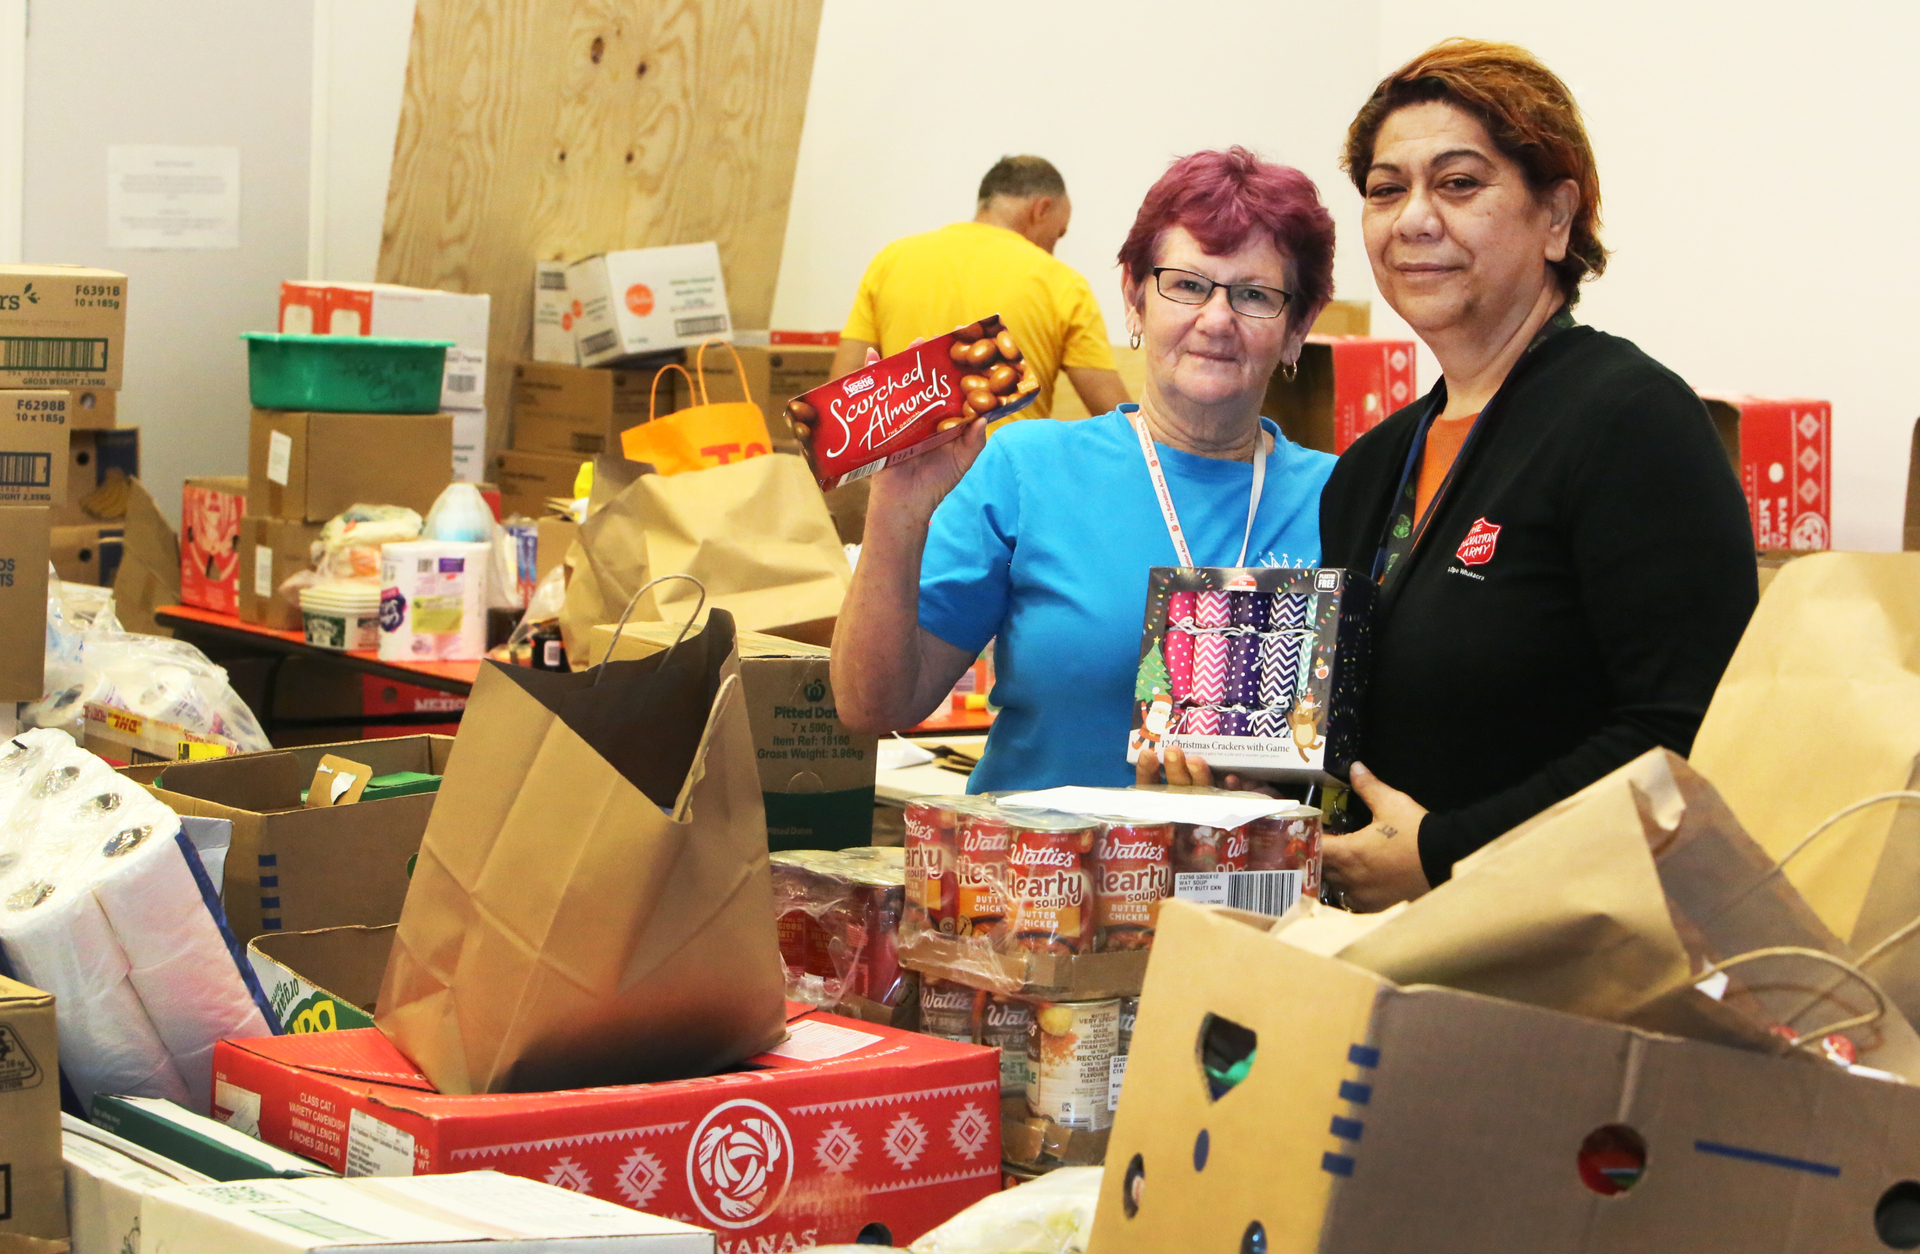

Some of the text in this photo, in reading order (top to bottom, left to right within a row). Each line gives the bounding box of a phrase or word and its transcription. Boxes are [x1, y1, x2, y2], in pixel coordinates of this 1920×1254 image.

[76, 285, 120, 296] F6391B
[75, 298, 86, 307] 10
[97, 298, 120, 310] 185g
[23, 377, 48, 385] GROSS
[49, 378, 78, 386] WEIGHT
[17, 400, 66, 411] F6298B
[827, 351, 924, 458] Scorched
[859, 368, 951, 450] Almonds
[16, 413, 28, 422] 10
[41, 413, 65, 424] 185g
[0, 493, 21, 501] IGHT
[1463, 544, 1491, 558] ARMY
[1318, 580, 1335, 589] FREE
[774, 706, 812, 718] Pitted
[113, 714, 137, 733] DHL
[791, 723, 798, 733] 7
[809, 723, 833, 735] 500g
[773, 736, 795, 746] Item
[1161, 740, 1290, 753] 12 Christmas Crackers with Game
[757, 748, 787, 759] Gross
[791, 748, 828, 761] Weight:
[1011, 843, 1076, 868] Wattie's
[1099, 838, 1165, 861] Wattie's
[1094, 863, 1169, 897] Hearty
[1007, 868, 1082, 906] Hearty
[976, 895, 999, 904] BUTT
[1127, 890, 1157, 903] soup
[974, 904, 1001, 912] CHICK
[1034, 898, 1067, 909] soup
[1111, 903, 1147, 912] BUTTER
[1109, 912, 1149, 921] CHICKEN
[287, 1000, 337, 1035] Dol
[300, 1092, 319, 1108] CLASS
[320, 1099, 332, 1111] CAT
[289, 1101, 346, 1132] VARIETY CAVENDISH
[293, 1130, 315, 1149] INCHES
[316, 1128, 341, 1144] LENGTH
